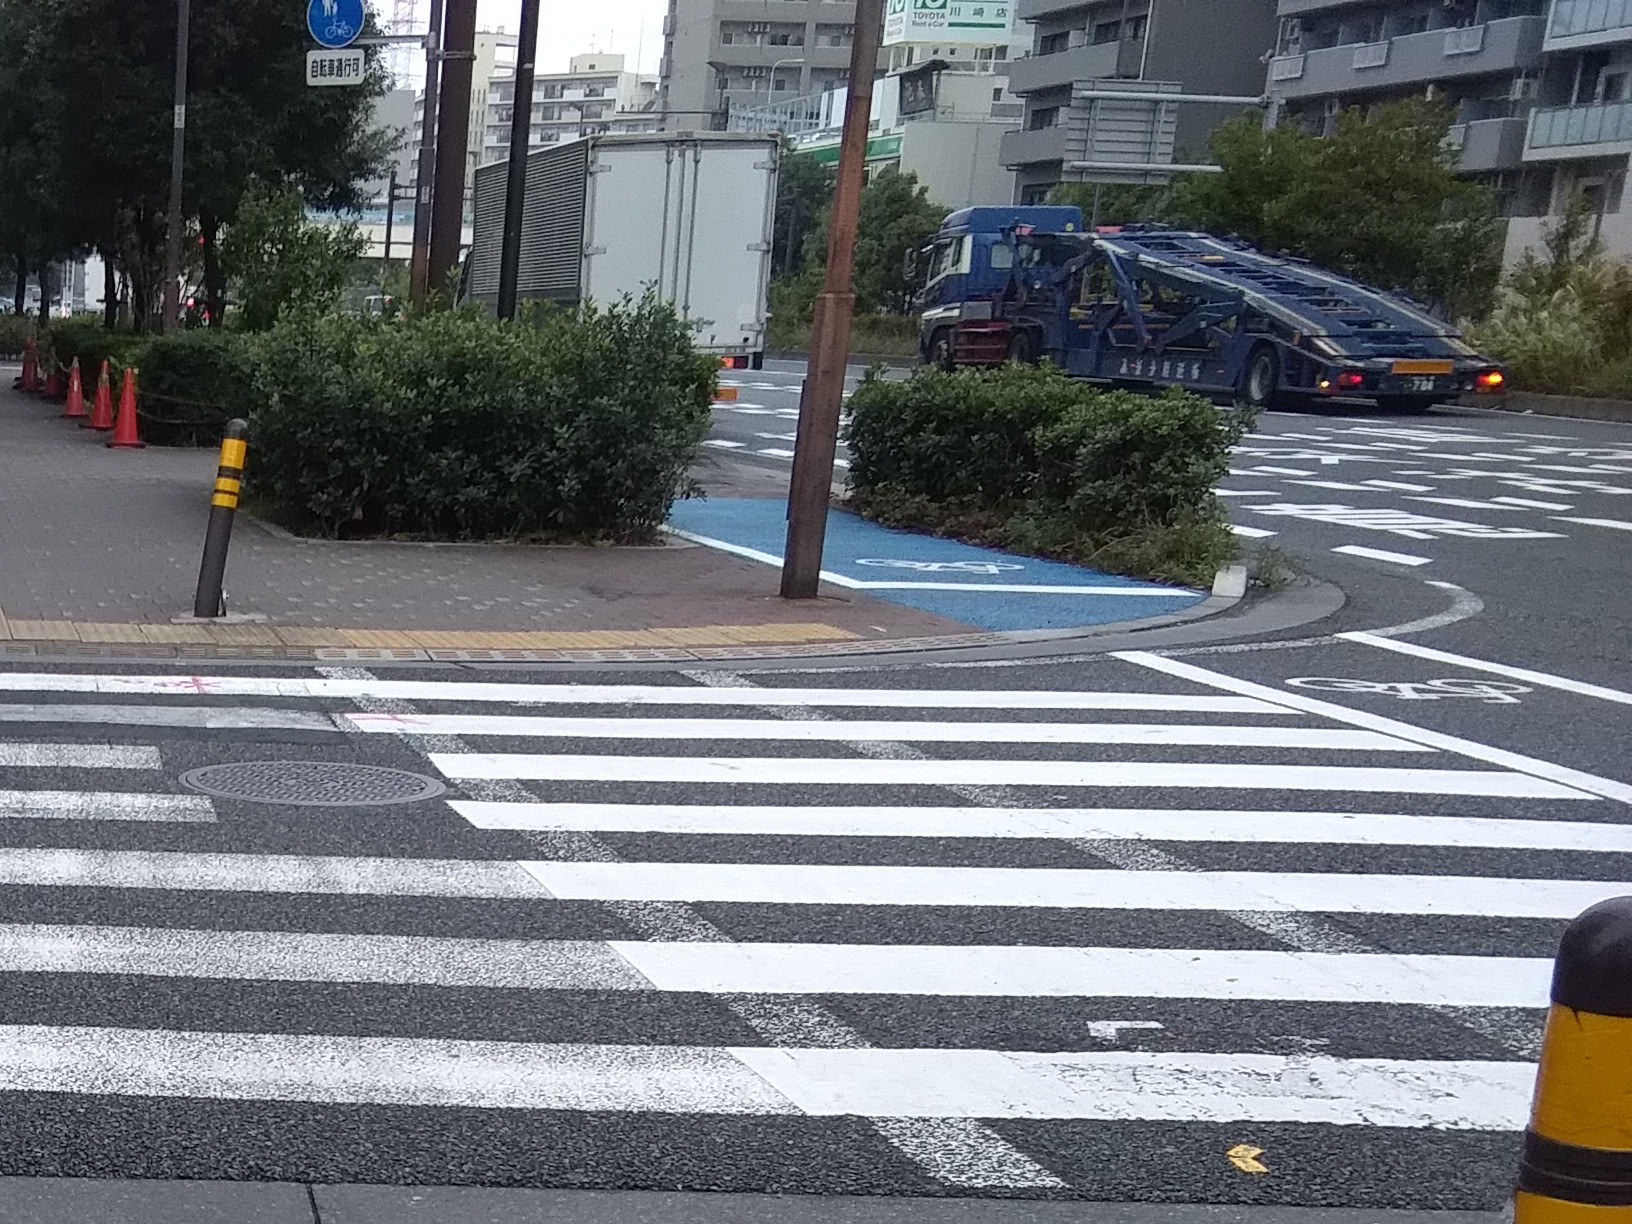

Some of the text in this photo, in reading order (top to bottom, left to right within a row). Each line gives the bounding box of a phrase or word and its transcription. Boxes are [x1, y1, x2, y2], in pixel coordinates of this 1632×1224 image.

[913, 11, 946, 20] TOYOTA
[311, 57, 361, 78] 自転車通行可
